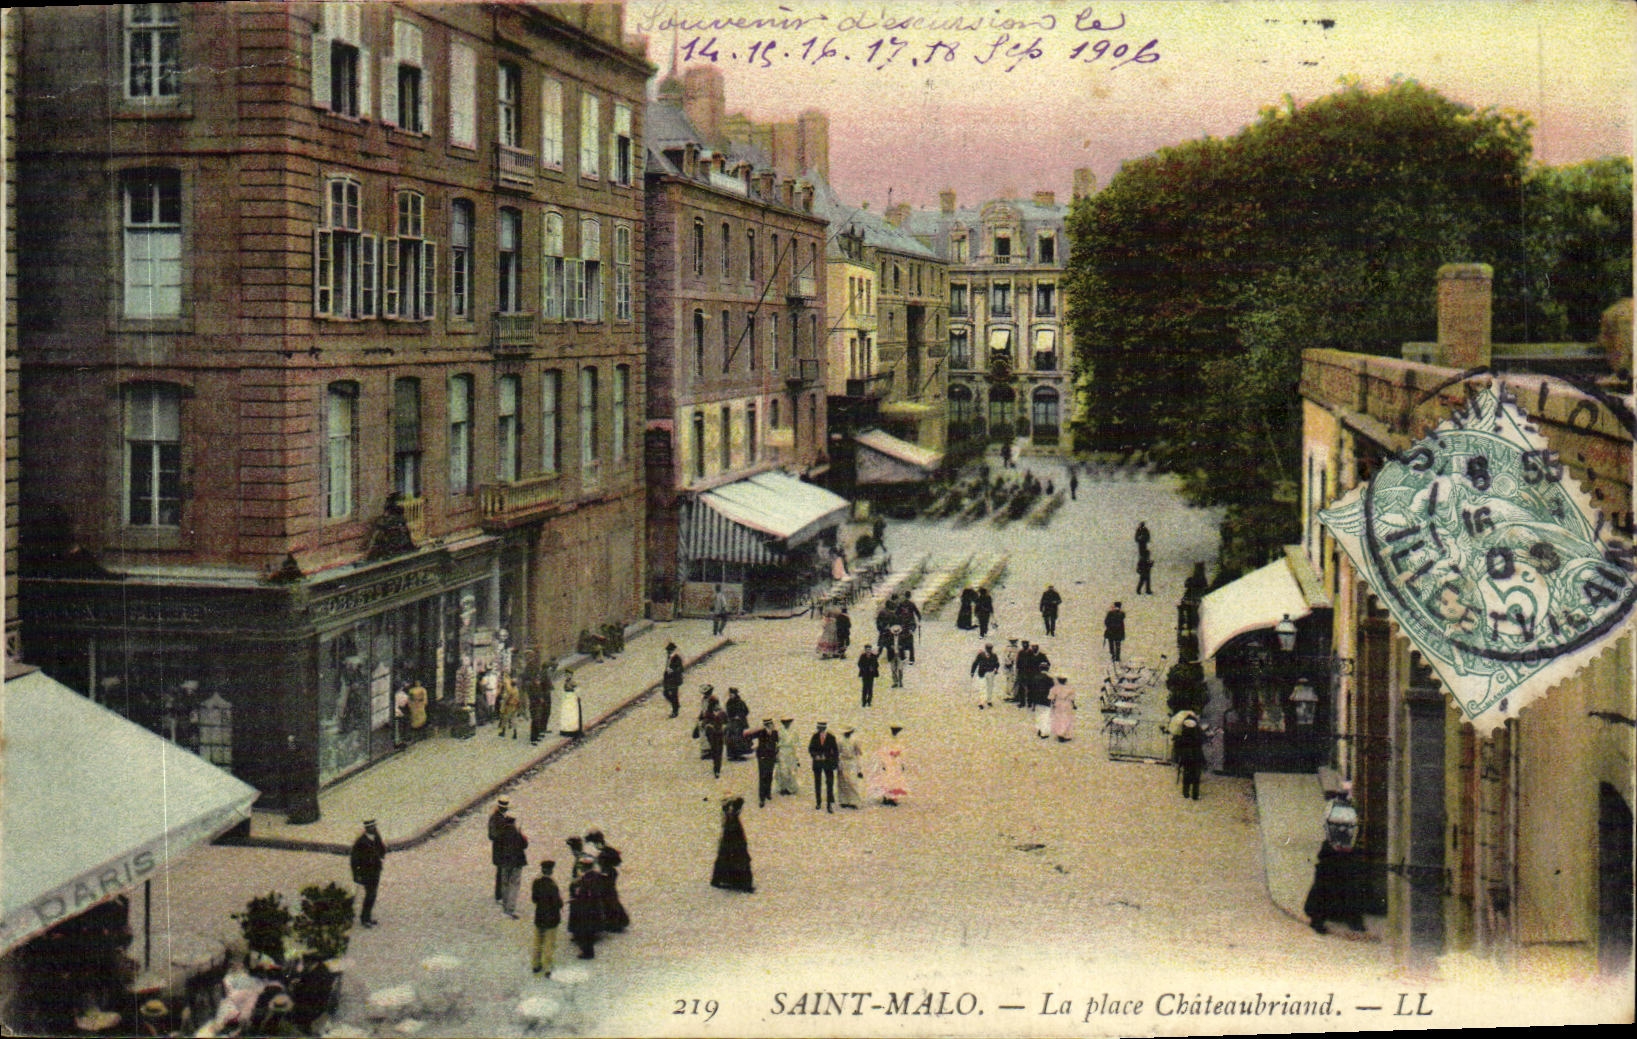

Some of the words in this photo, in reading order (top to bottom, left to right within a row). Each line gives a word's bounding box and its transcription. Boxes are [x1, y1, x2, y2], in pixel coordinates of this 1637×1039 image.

[636, 2, 828, 33] Souvenir
[1074, 7, 1125, 31] le
[1069, 38, 1160, 71] 1906
